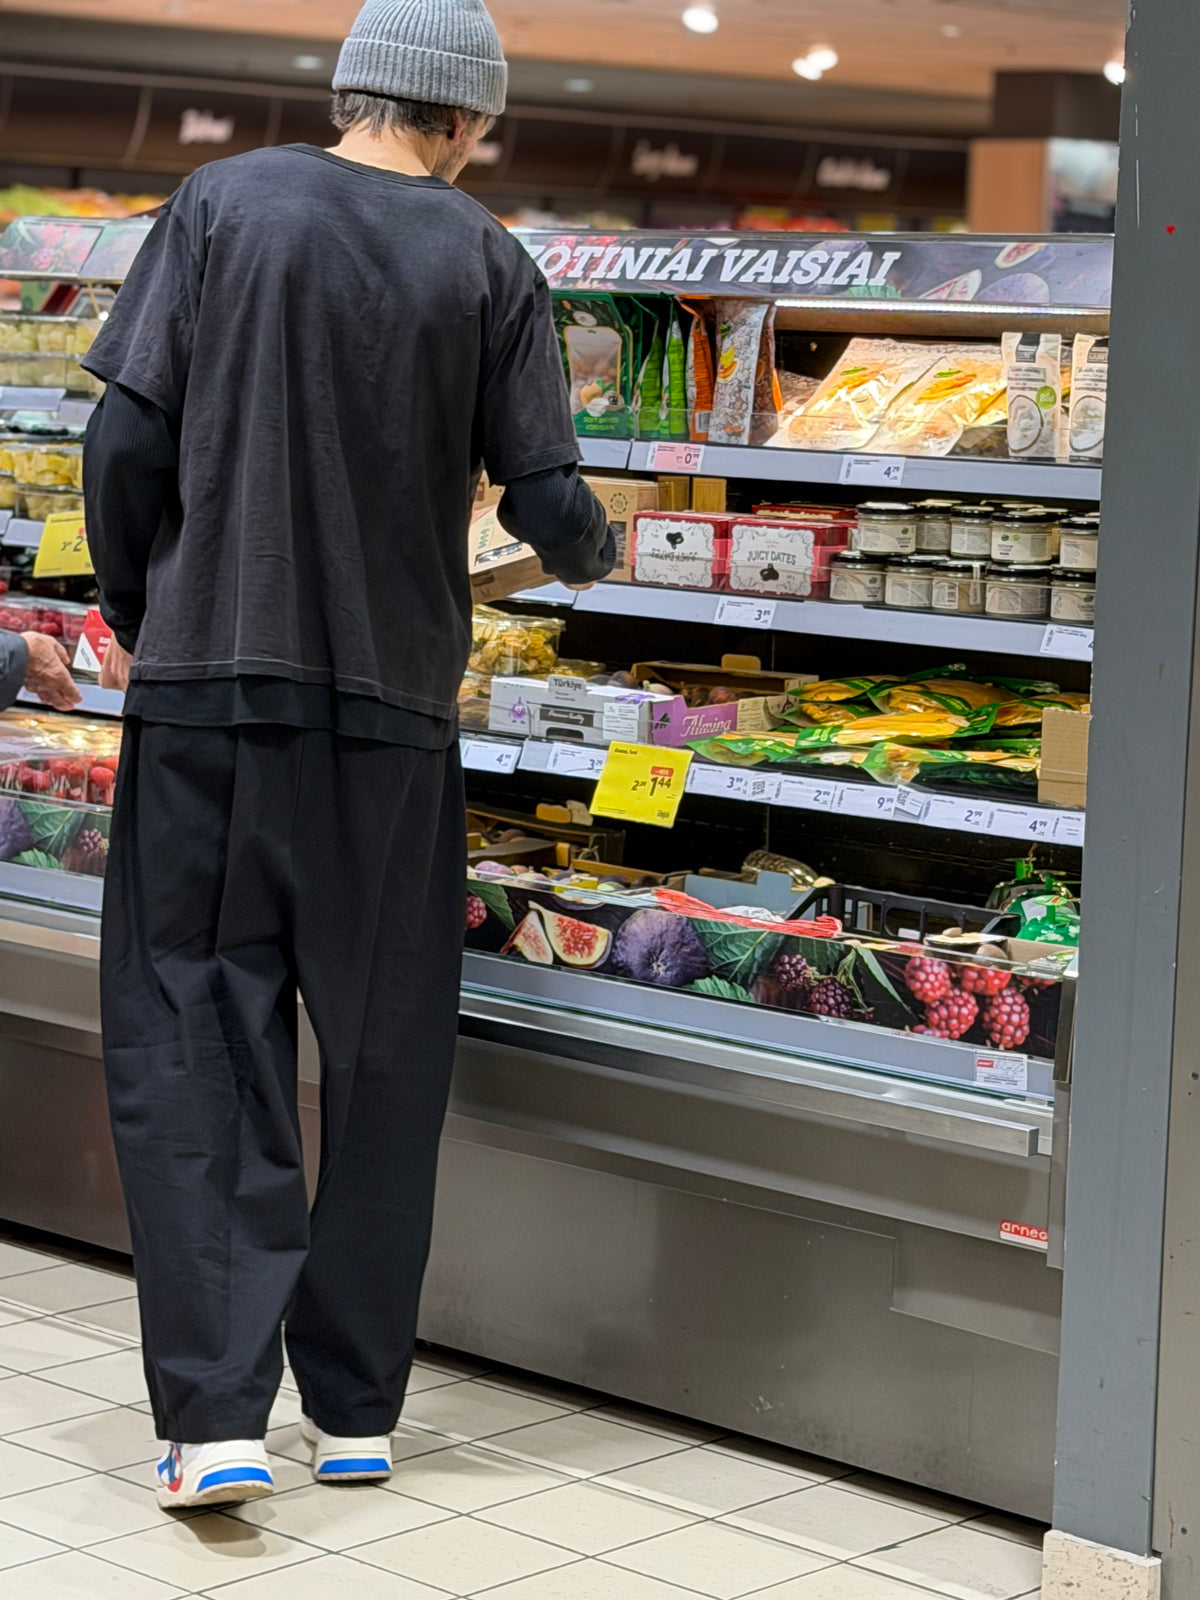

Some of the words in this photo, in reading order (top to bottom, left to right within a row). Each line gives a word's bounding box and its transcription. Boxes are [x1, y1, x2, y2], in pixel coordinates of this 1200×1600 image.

[718, 248, 902, 286] VAISIAI
[747, 550, 769, 562] JUICY
[770, 551, 797, 566] DATES
[553, 678, 583, 692] Türkiye
[680, 714, 733, 738] Almina
